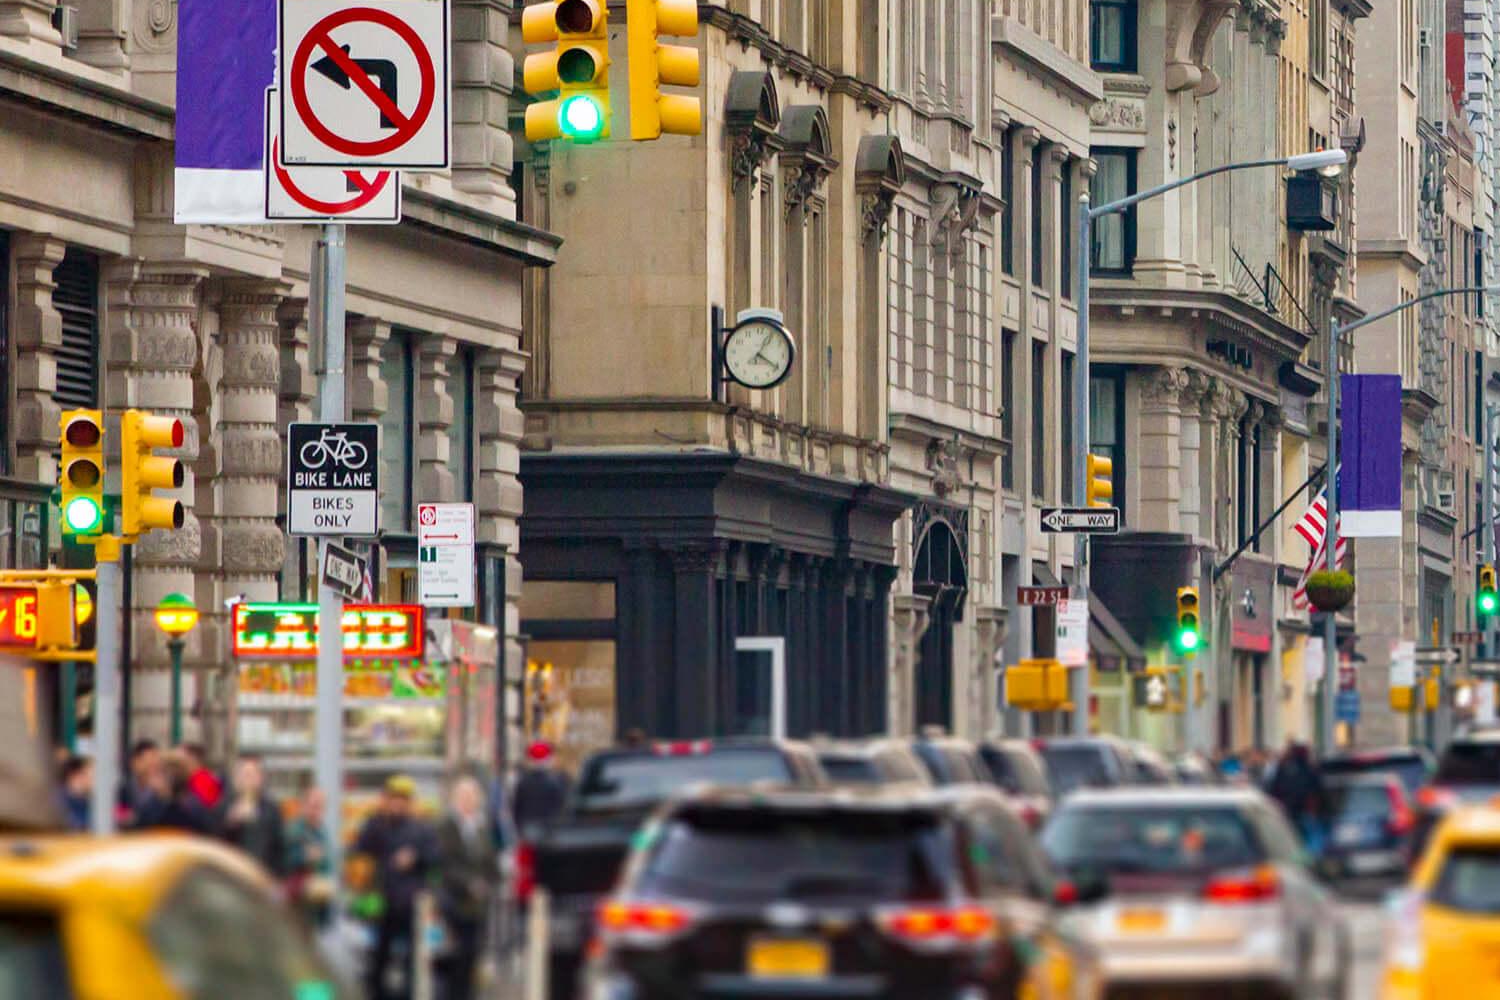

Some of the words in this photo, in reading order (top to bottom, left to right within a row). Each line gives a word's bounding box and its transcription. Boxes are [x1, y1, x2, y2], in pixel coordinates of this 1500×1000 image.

[295, 471, 327, 487] BIKE
[333, 472, 372, 487] LANE
[312, 497, 354, 510] BIKES
[314, 514, 352, 527] ONLY
[1048, 514, 1073, 526] ONE
[1088, 515, 1112, 526] WAY
[330, 557, 343, 579] ONE
[346, 566, 359, 586] WAY
[1033, 591, 1046, 604] 22
[15, 597, 37, 638] 16
